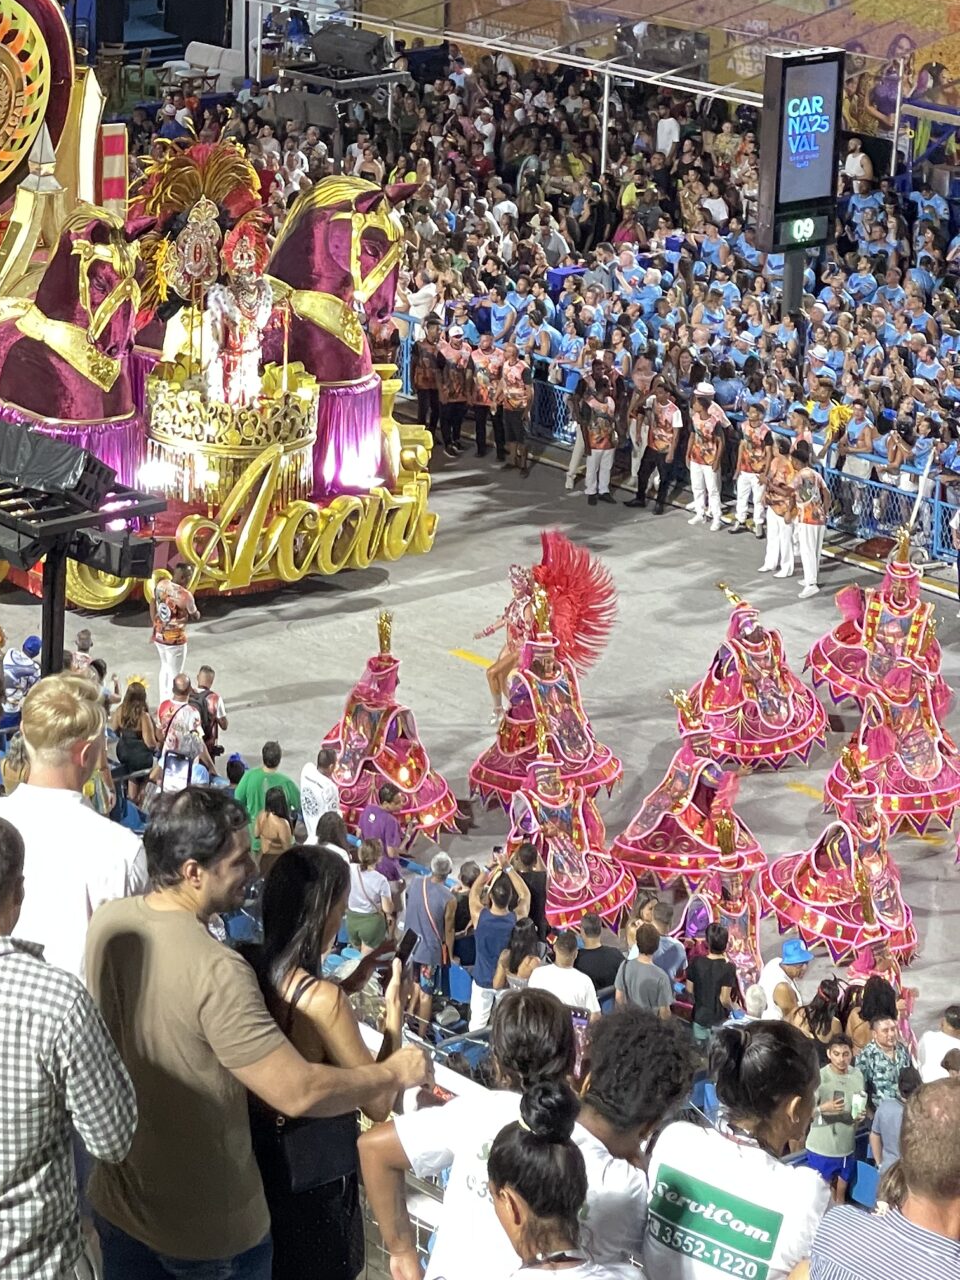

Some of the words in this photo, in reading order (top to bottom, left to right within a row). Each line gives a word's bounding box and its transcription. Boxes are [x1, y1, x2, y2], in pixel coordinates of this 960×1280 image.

[788, 95, 824, 118] CAR
[788, 133, 820, 154] VAL
[792, 217, 815, 240] 09
[661, 1226, 759, 1279] 3552-1220
